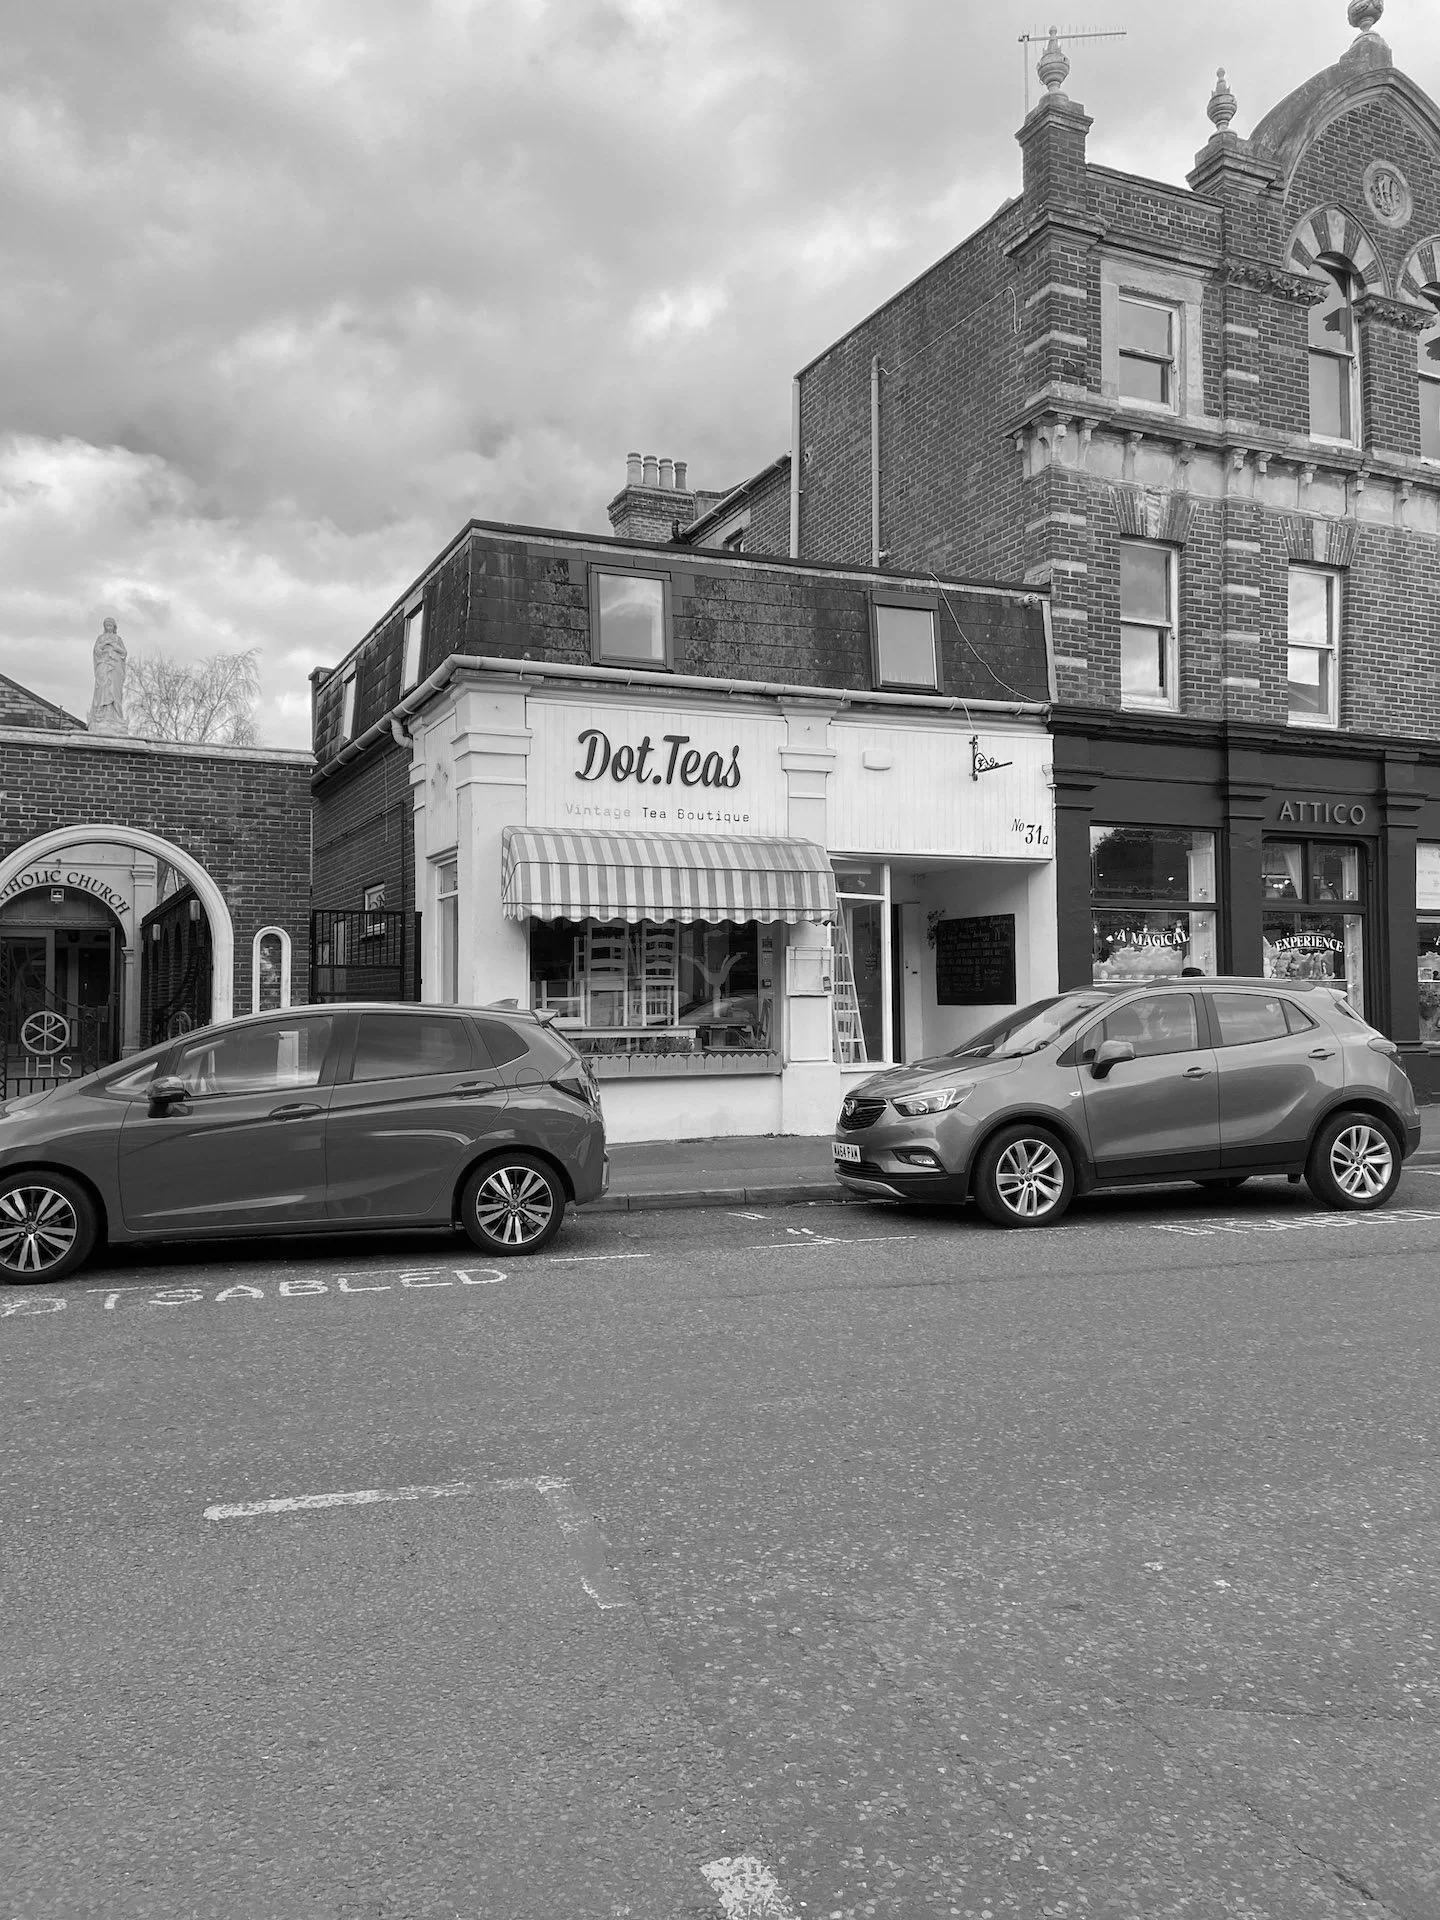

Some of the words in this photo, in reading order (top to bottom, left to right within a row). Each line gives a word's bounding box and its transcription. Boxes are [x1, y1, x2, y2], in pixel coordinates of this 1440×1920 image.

[574, 728, 741, 788] Dot.Teas
[565, 803, 631, 819] Vintage
[642, 807, 667, 819] Tea
[677, 808, 750, 823] Boutique
[1279, 800, 1366, 825] ATTICO
[1025, 823, 1049, 845] 31a
[66, 871, 131, 916] CHURCH
[1116, 928, 1127, 942] A
[1131, 930, 1190, 947] MAGICAL
[1275, 935, 1344, 953] EXPERIENCE
[25, 1056, 73, 1078] IHS
